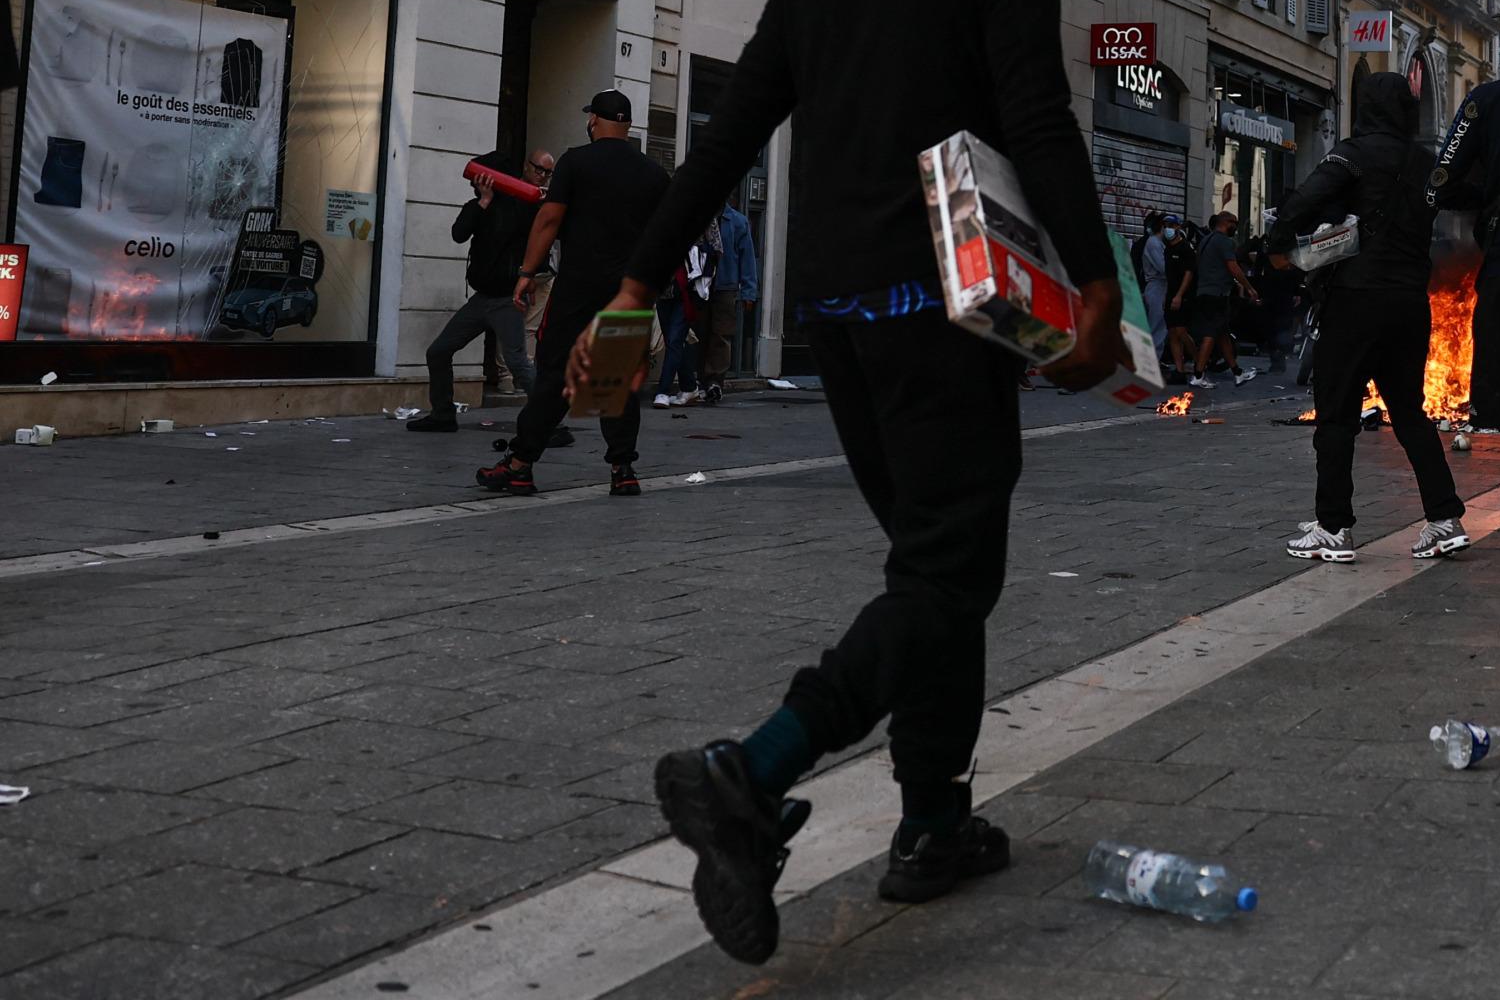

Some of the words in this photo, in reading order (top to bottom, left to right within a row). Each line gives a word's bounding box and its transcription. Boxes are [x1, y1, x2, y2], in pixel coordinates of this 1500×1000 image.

[1352, 20, 1387, 42] H&M
[621, 42, 632, 57] 67
[1096, 46, 1147, 60] LISSAC
[1117, 65, 1162, 100] LISSAC
[117, 90, 129, 105] le
[132, 94, 162, 110] goût
[166, 97, 189, 112] des
[151, 113, 173, 123] porter
[174, 116, 190, 124] sans
[1440, 118, 1471, 165] VERSACE
[124, 236, 175, 258] celio
[0, 267, 16, 280] K.
